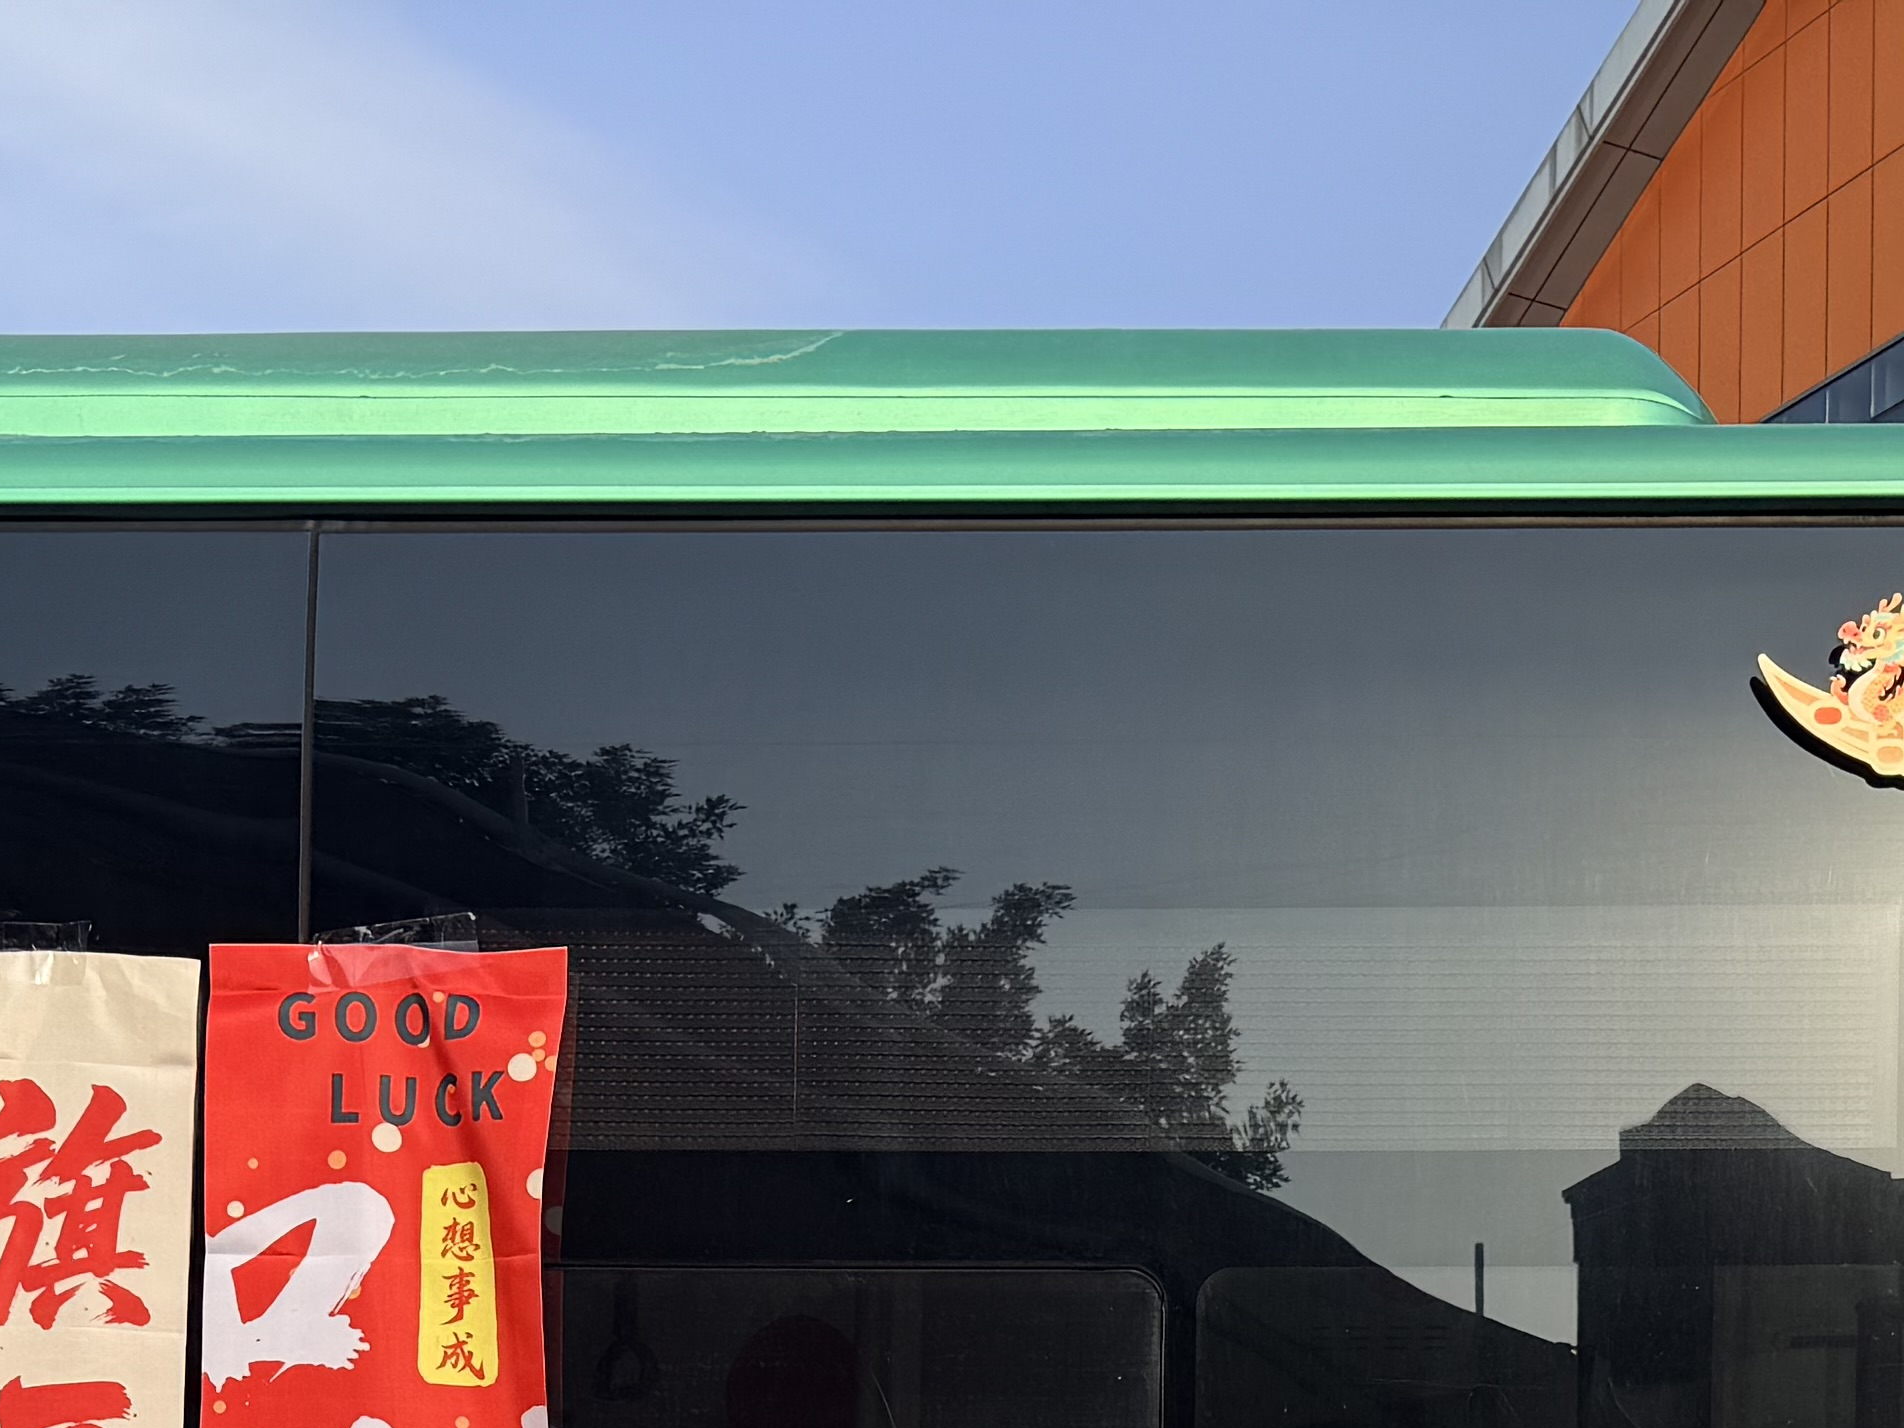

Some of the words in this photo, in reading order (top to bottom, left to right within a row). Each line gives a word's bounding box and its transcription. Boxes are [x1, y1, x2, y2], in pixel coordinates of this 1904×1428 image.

[278, 991, 481, 1046] GOOD
[329, 1070, 505, 1127] LUCK
[436, 1182, 485, 1380] 心想事成
